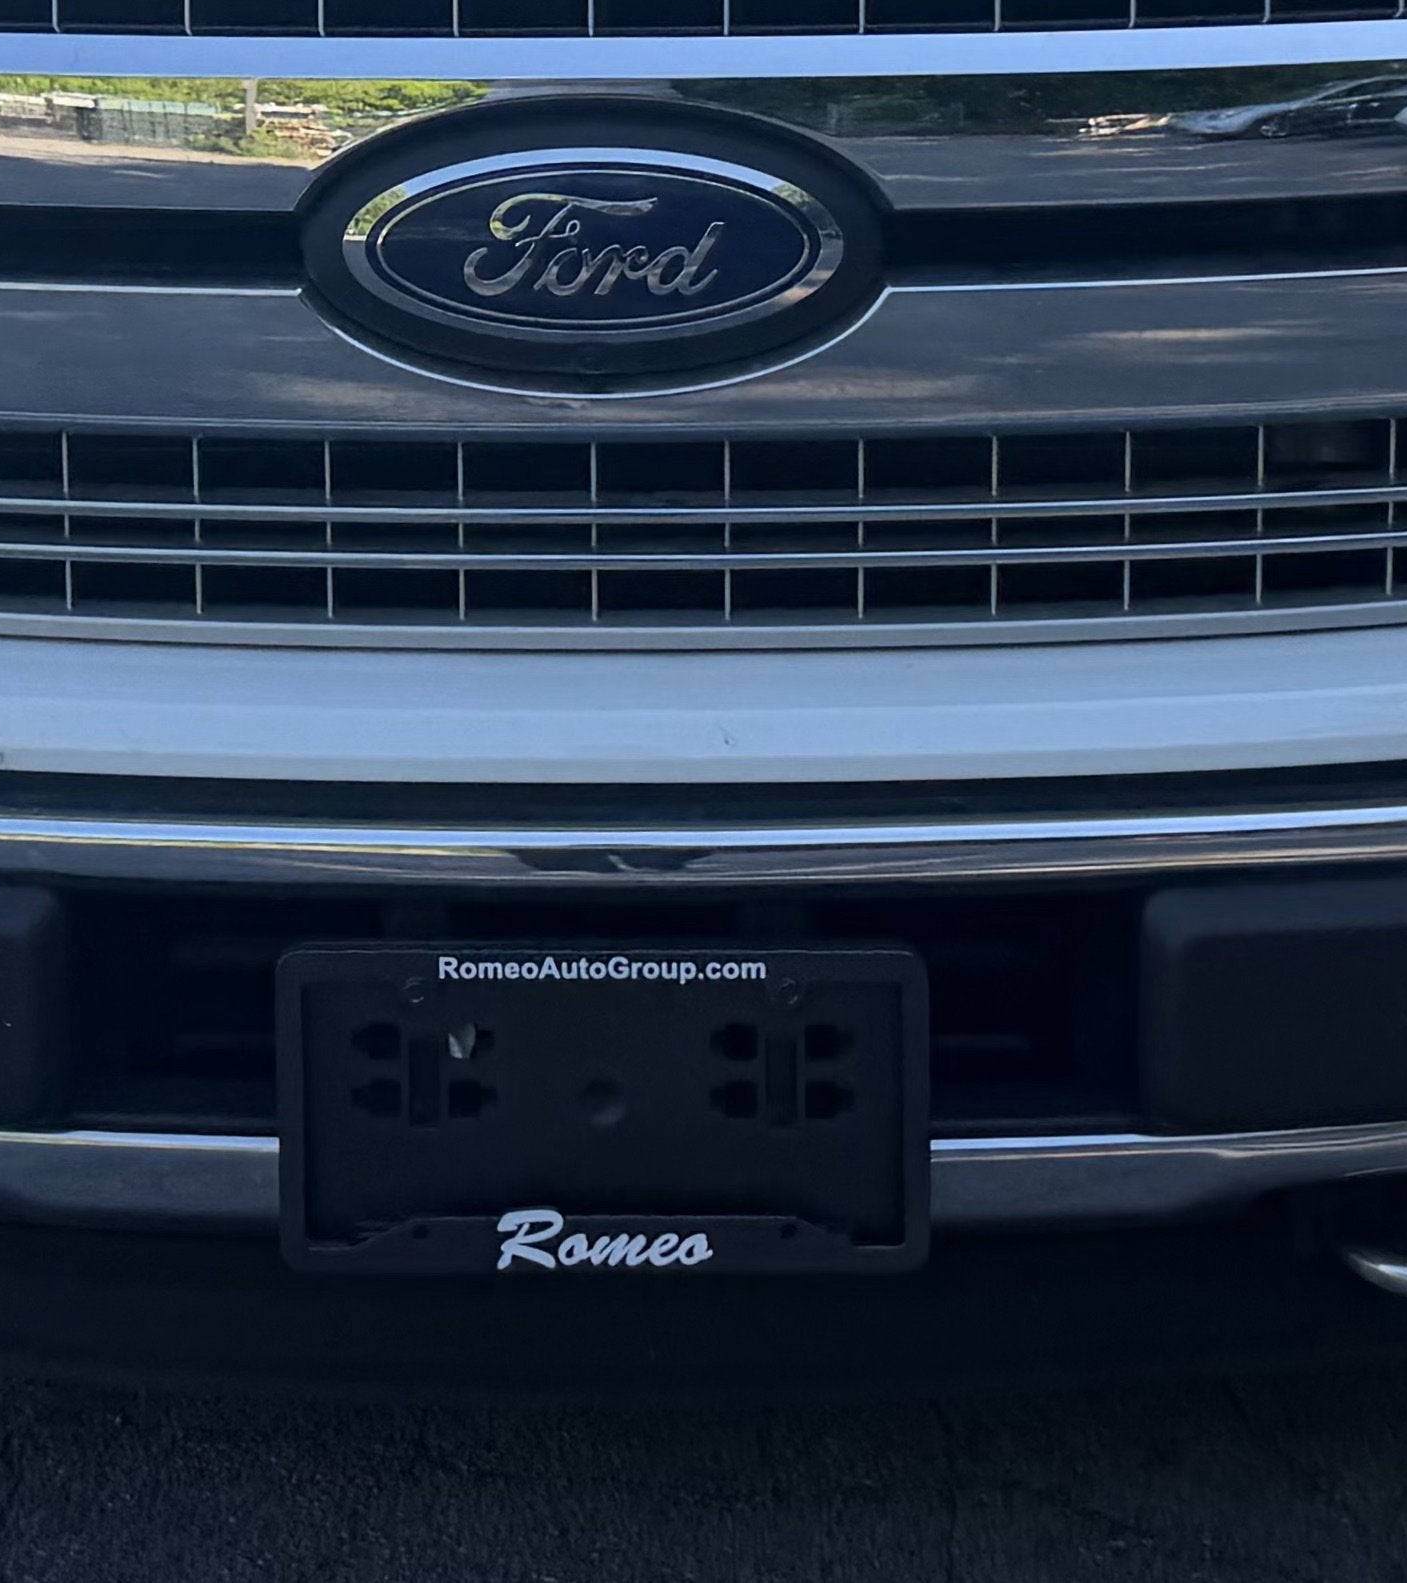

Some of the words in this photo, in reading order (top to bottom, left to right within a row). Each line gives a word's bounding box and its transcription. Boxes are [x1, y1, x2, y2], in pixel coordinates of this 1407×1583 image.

[463, 193, 726, 297] Ford
[437, 956, 767, 985] RomeoAutoGroup.com
[496, 1209, 713, 1270] Romeo
